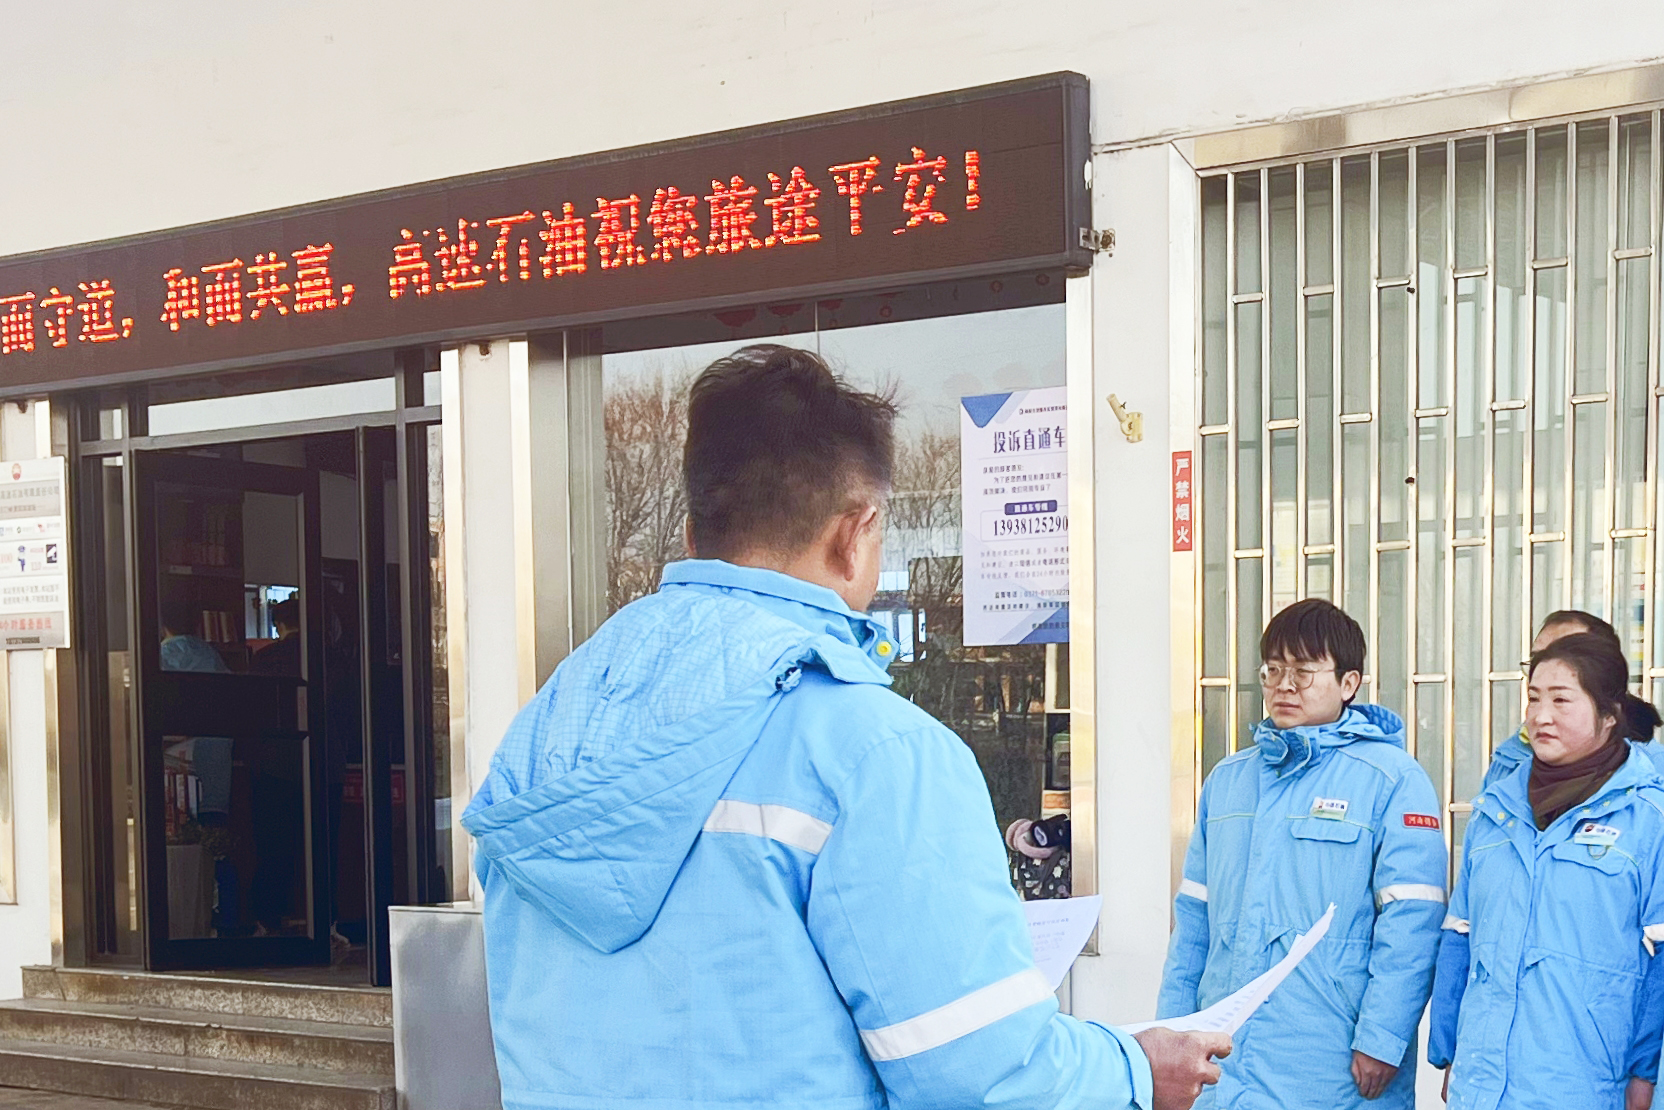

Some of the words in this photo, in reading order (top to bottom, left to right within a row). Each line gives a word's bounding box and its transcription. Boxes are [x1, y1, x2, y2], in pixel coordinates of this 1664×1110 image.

[993, 425, 1066, 454] 投诉直通车
[1174, 457, 1190, 545] 严禁烟火
[993, 515, 1069, 536] 13938125290
